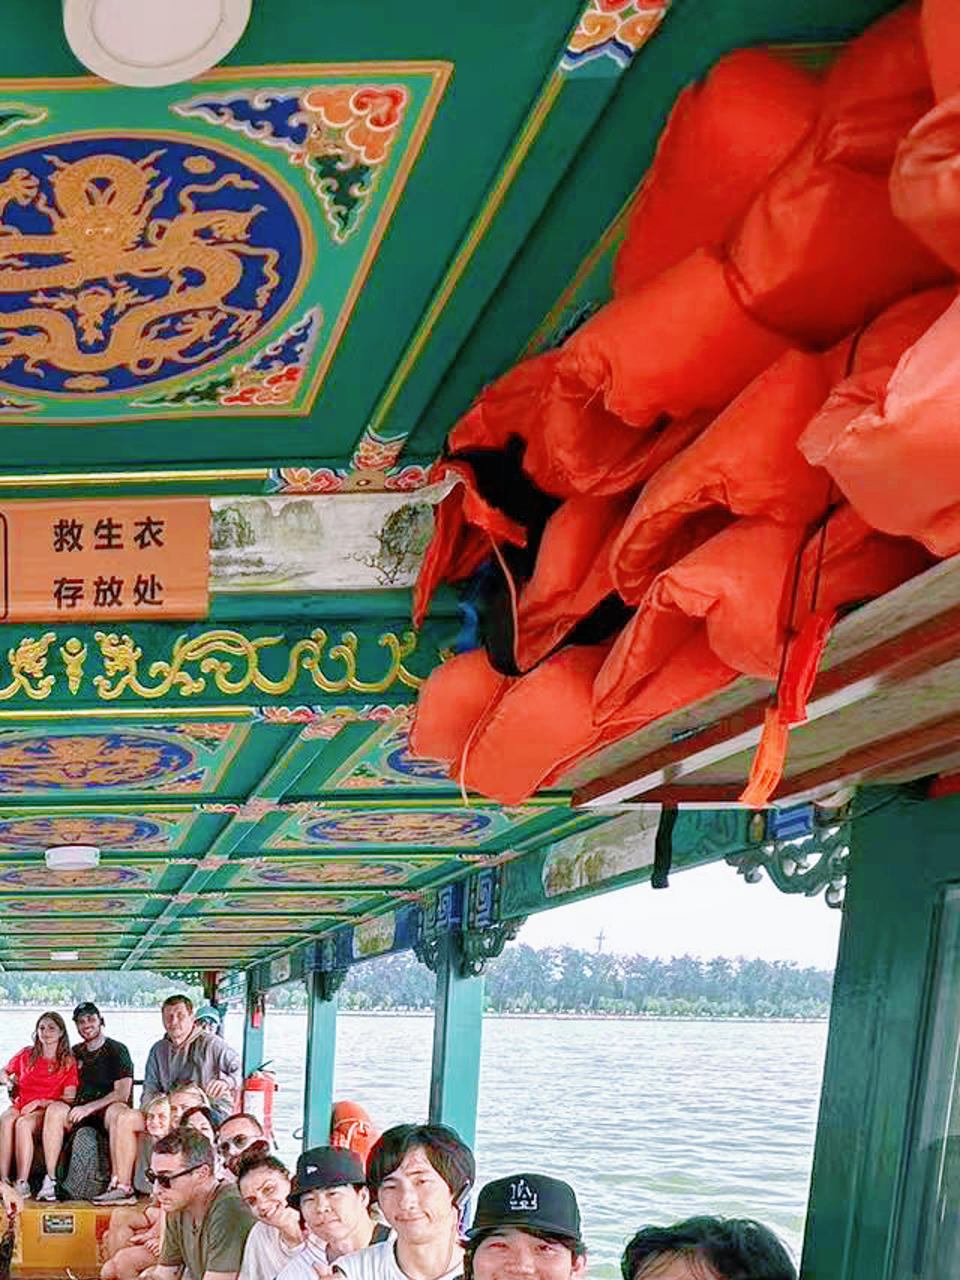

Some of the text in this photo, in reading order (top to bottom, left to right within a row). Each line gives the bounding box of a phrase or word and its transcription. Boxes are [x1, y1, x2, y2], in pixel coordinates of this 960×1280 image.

[53, 516, 164, 552] 救生衣
[53, 574, 163, 609] 存放处
[509, 1179, 538, 1210] LA
